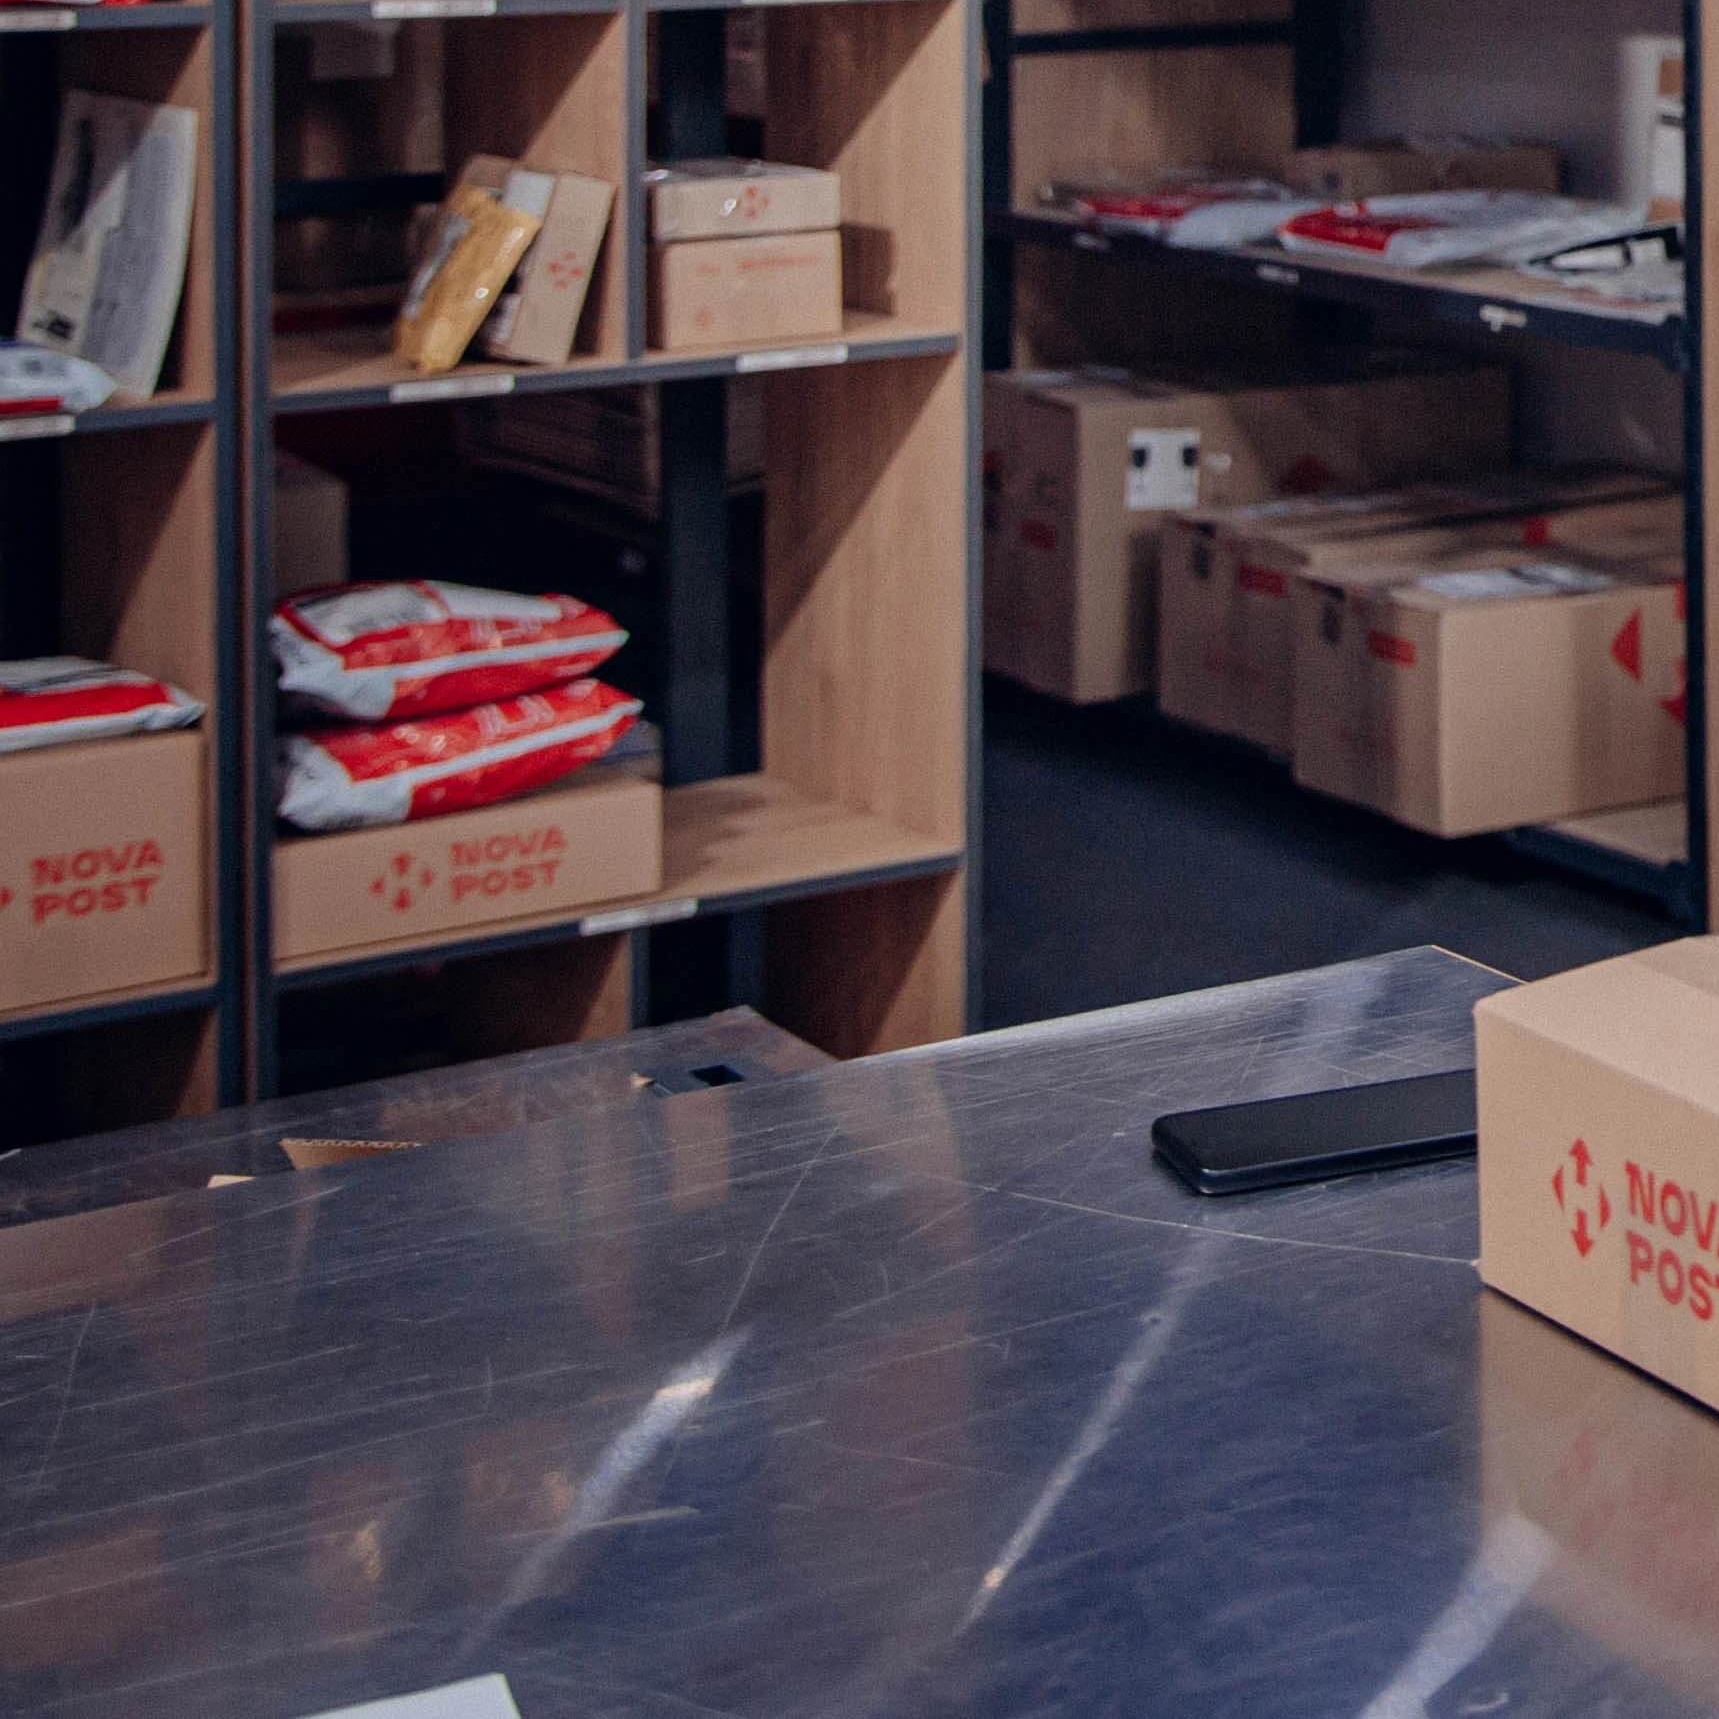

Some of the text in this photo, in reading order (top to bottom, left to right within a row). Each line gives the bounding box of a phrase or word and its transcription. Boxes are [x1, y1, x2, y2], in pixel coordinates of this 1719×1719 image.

[31, 837, 165, 887] NOVA
[452, 826, 567, 867] NOVA
[32, 875, 161, 925] POST
[452, 858, 562, 904] POST
